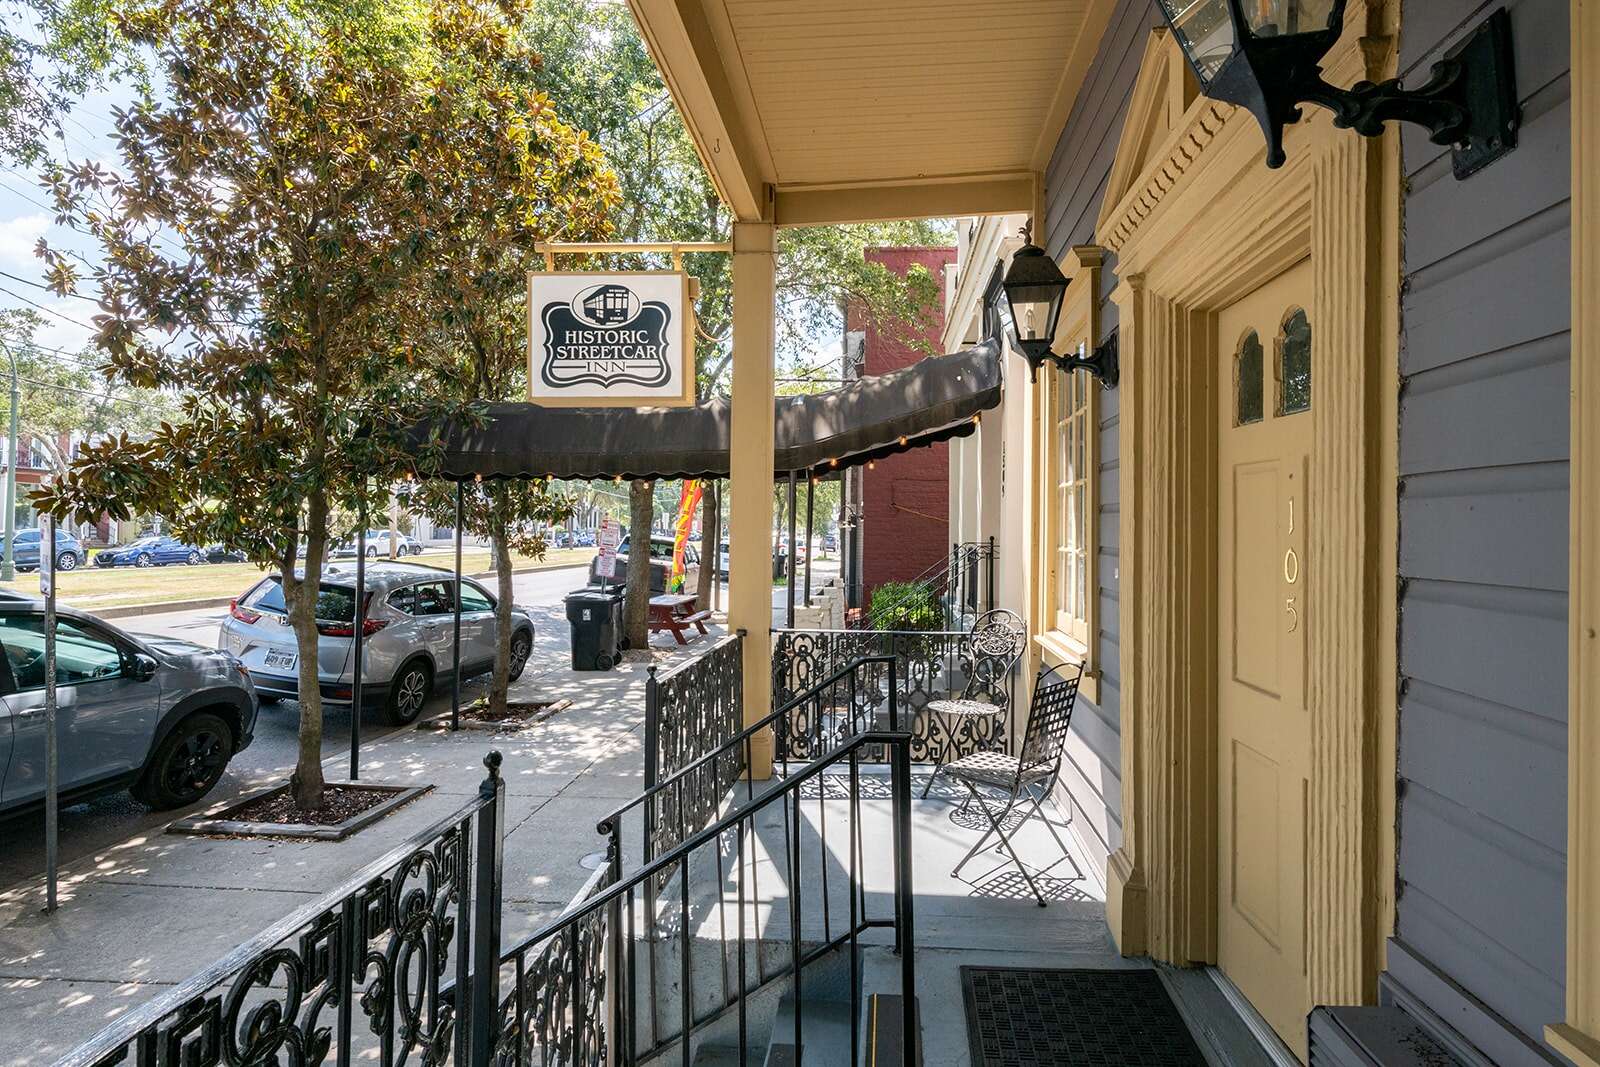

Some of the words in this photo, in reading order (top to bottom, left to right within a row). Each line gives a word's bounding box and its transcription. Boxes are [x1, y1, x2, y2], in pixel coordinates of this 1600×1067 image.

[564, 330, 649, 344] HISTORIC
[556, 345, 658, 359] STREETCAR
[586, 361, 626, 373] INN
